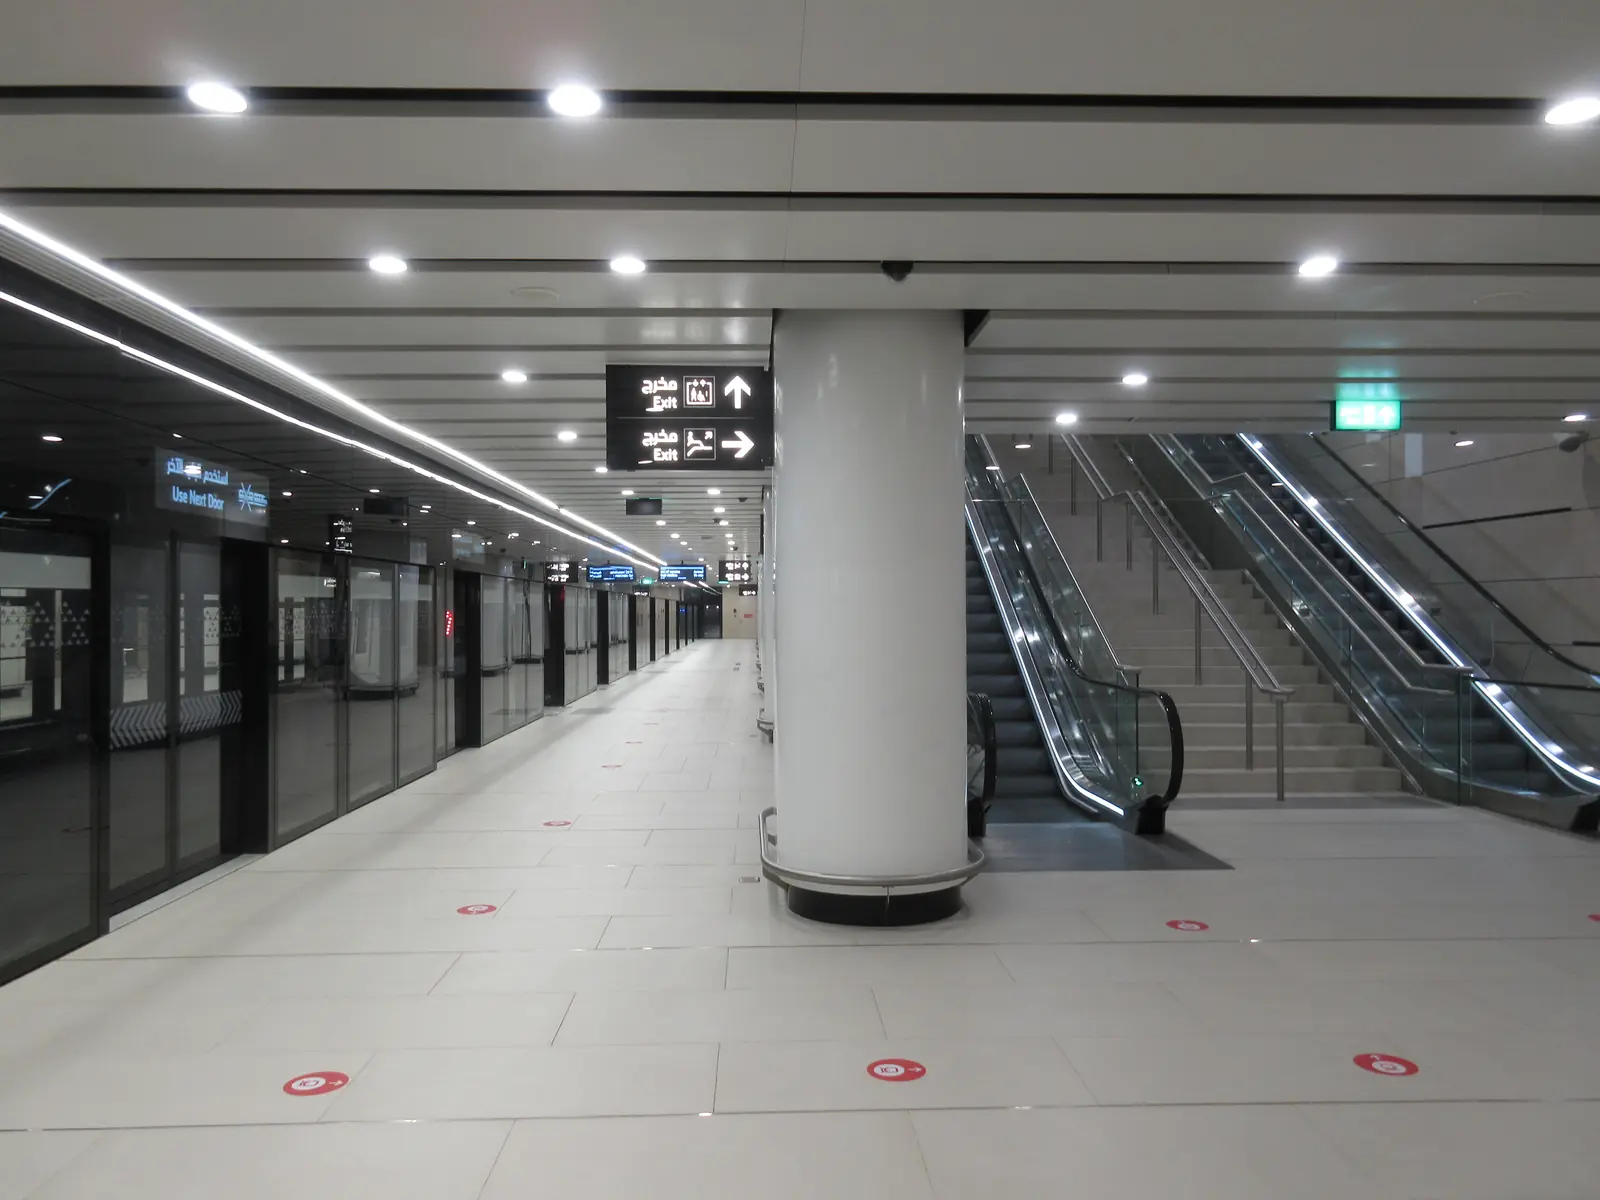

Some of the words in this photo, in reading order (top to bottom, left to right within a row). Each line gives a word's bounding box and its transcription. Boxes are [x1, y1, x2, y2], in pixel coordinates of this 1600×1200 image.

[641, 376, 678, 395] مخرج
[653, 395, 678, 409] Exit
[641, 428, 679, 447] مخرج
[653, 447, 678, 462] Exit
[172, 485, 188, 504] Use
[189, 488, 207, 508] Next
[207, 492, 224, 511] Door
